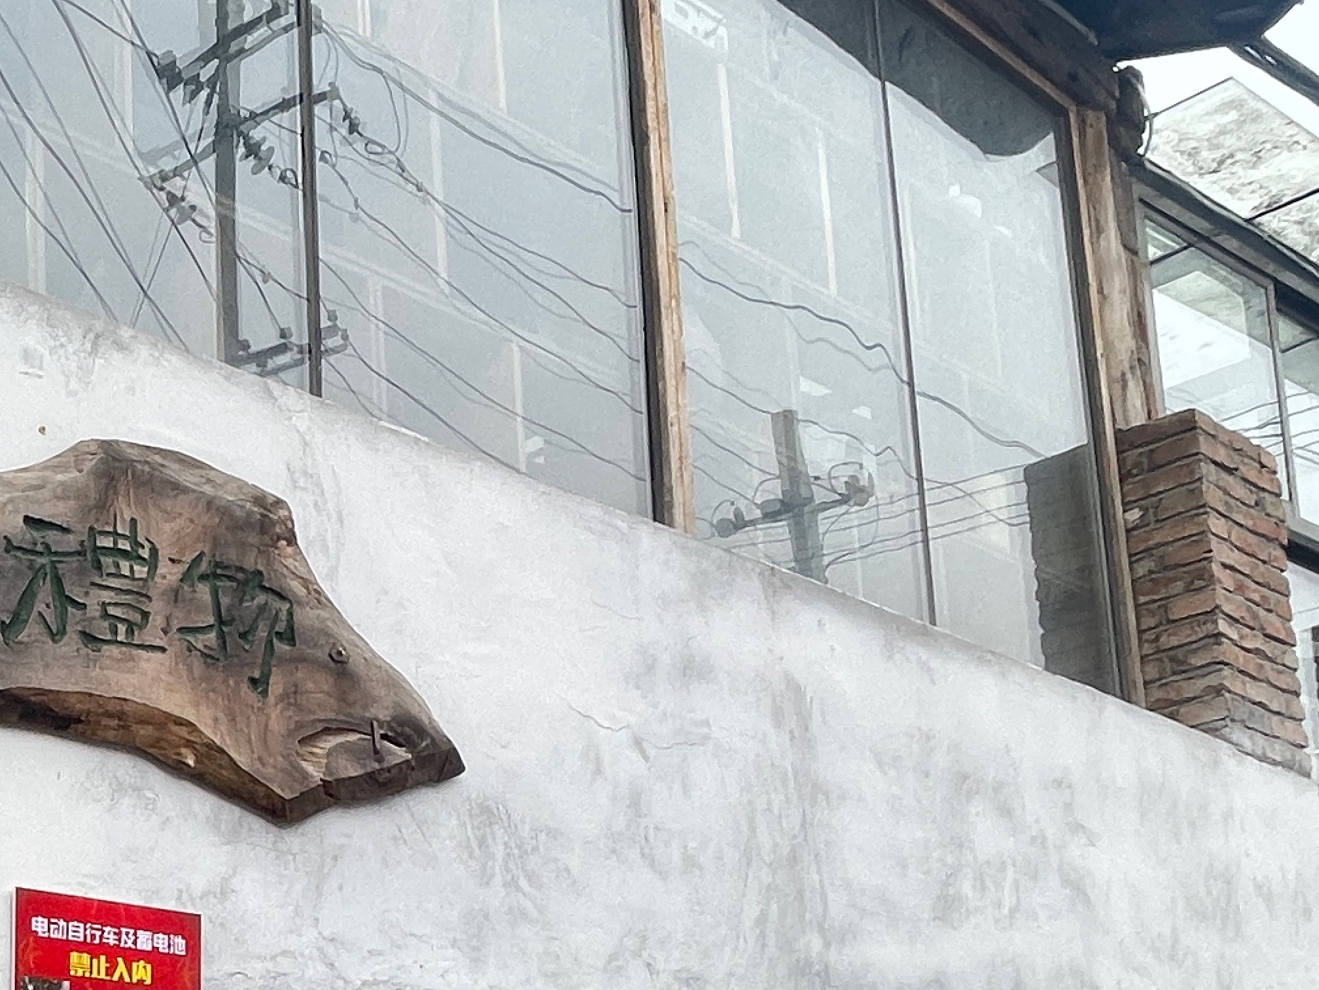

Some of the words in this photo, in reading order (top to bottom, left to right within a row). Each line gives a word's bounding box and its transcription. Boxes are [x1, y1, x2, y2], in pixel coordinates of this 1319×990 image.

[31, 915, 187, 956] 电动自行车及蓄电池
[69, 950, 153, 986] 禁止入内
